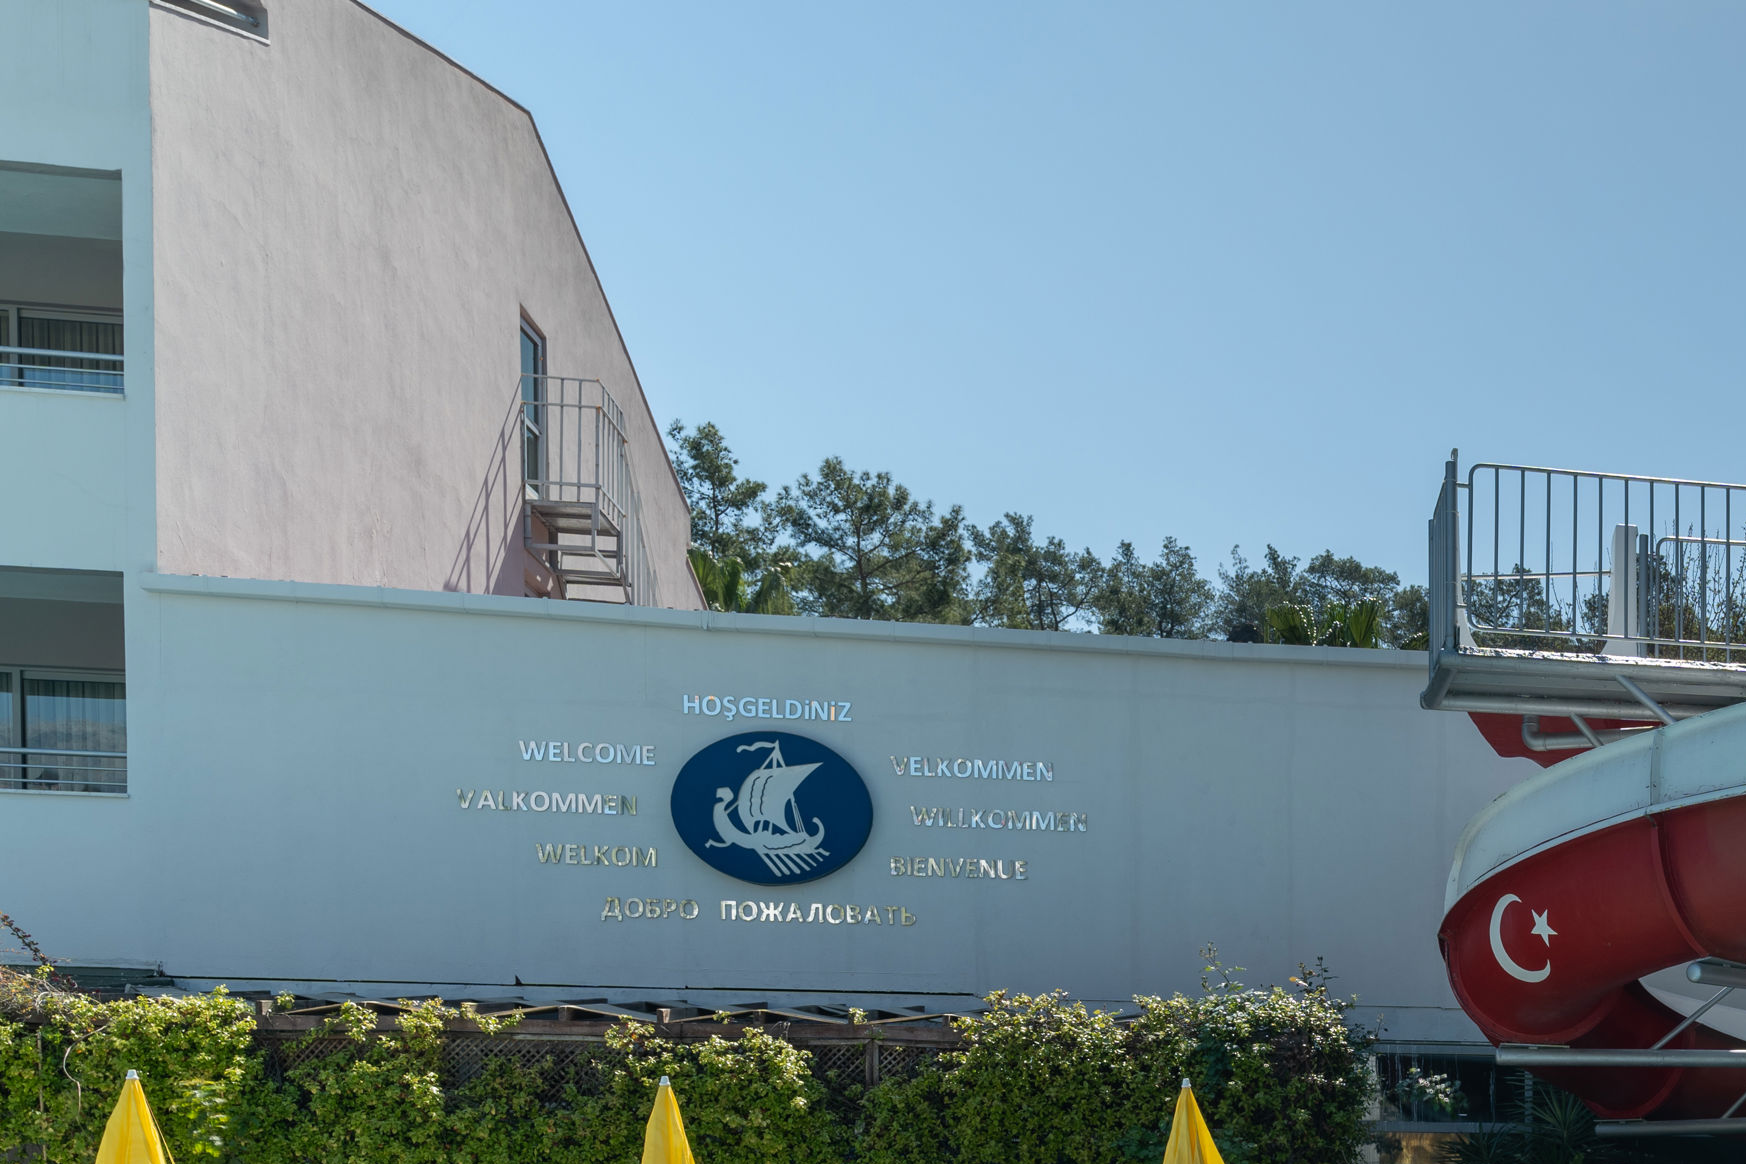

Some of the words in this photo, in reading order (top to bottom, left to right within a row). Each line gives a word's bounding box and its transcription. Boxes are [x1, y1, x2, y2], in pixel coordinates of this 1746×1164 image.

[518, 740, 656, 766] WELCOME
[890, 755, 1053, 782] VELKOMMEN
[456, 788, 638, 816] VALKOMMEN
[910, 805, 1088, 833] WILLKOMMEN
[535, 843, 658, 868] WELKOM
[889, 856, 1028, 881] BIENVENUE
[600, 896, 699, 922] ДОБРО
[719, 900, 917, 926] ПОЖАЛОВАТЬ
